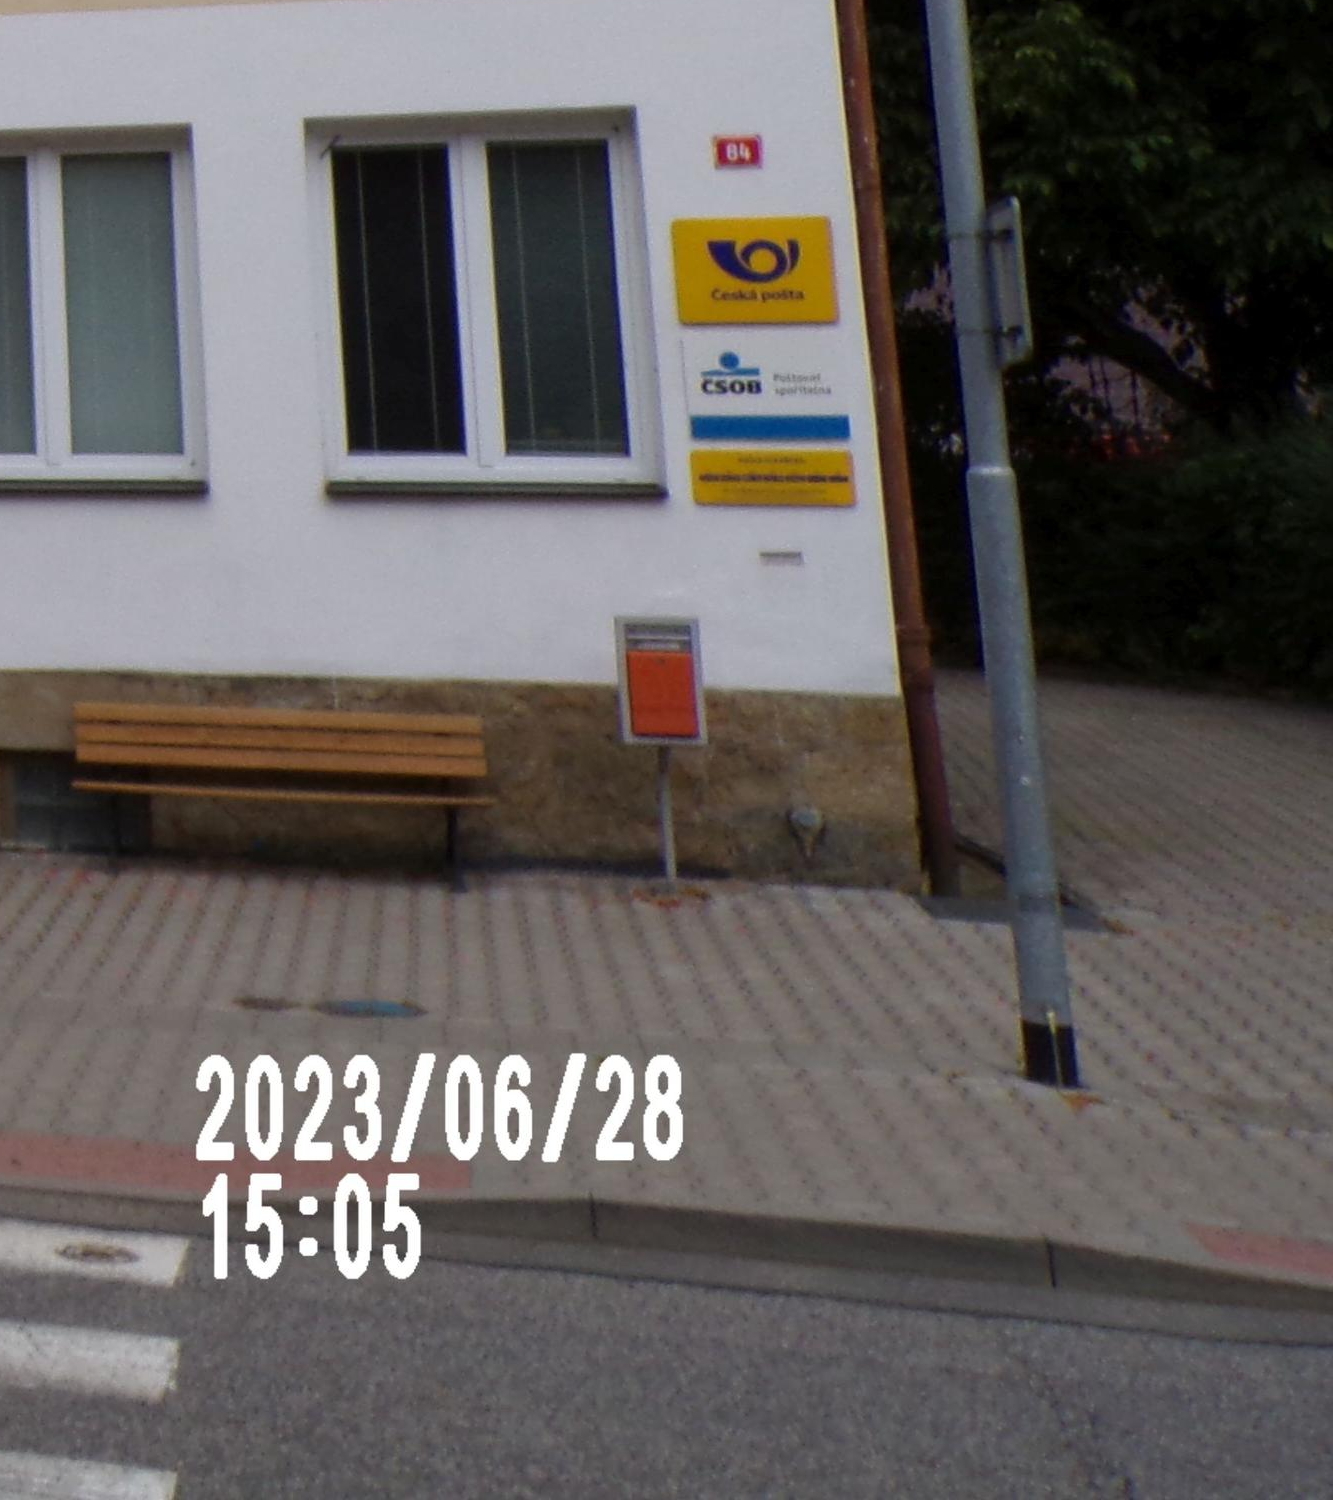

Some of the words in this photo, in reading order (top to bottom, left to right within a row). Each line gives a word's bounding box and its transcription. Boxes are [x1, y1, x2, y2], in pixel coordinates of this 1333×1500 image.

[726, 142, 752, 162] 84
[711, 287, 758, 301] Česká
[761, 288, 805, 303] pošta
[700, 377, 763, 395] ČSOB
